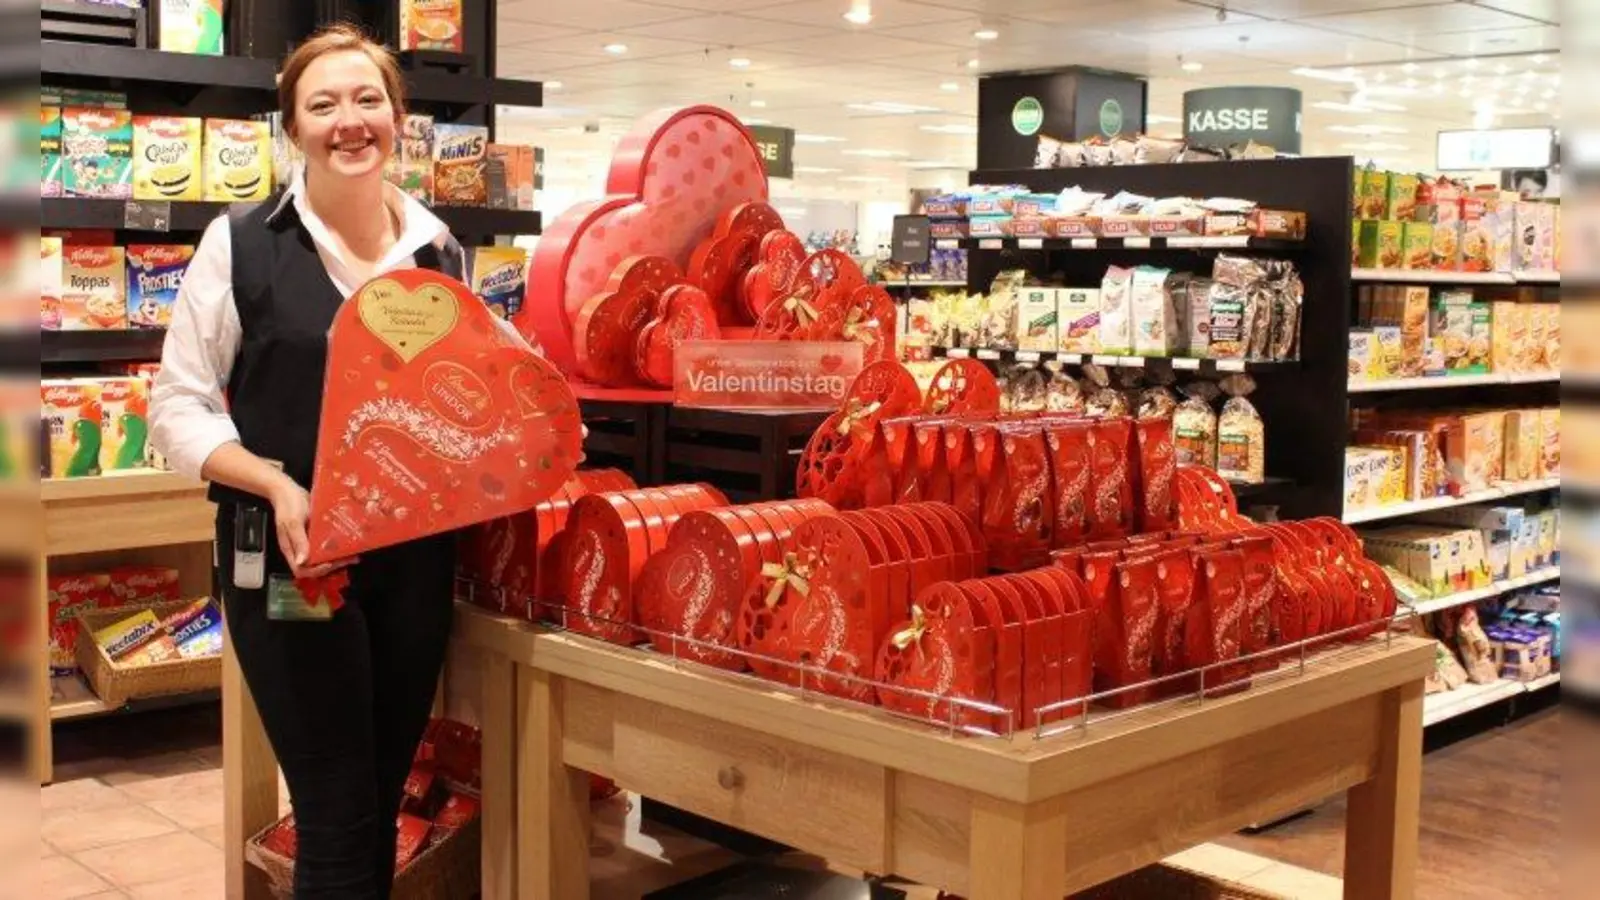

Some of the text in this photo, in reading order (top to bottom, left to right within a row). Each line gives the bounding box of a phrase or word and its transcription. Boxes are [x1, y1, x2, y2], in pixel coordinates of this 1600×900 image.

[1188, 108, 1268, 132] KASSE
[70, 274, 110, 291] Toppas
[686, 368, 846, 399] Valentinstag
[431, 382, 472, 421] LINDOR
